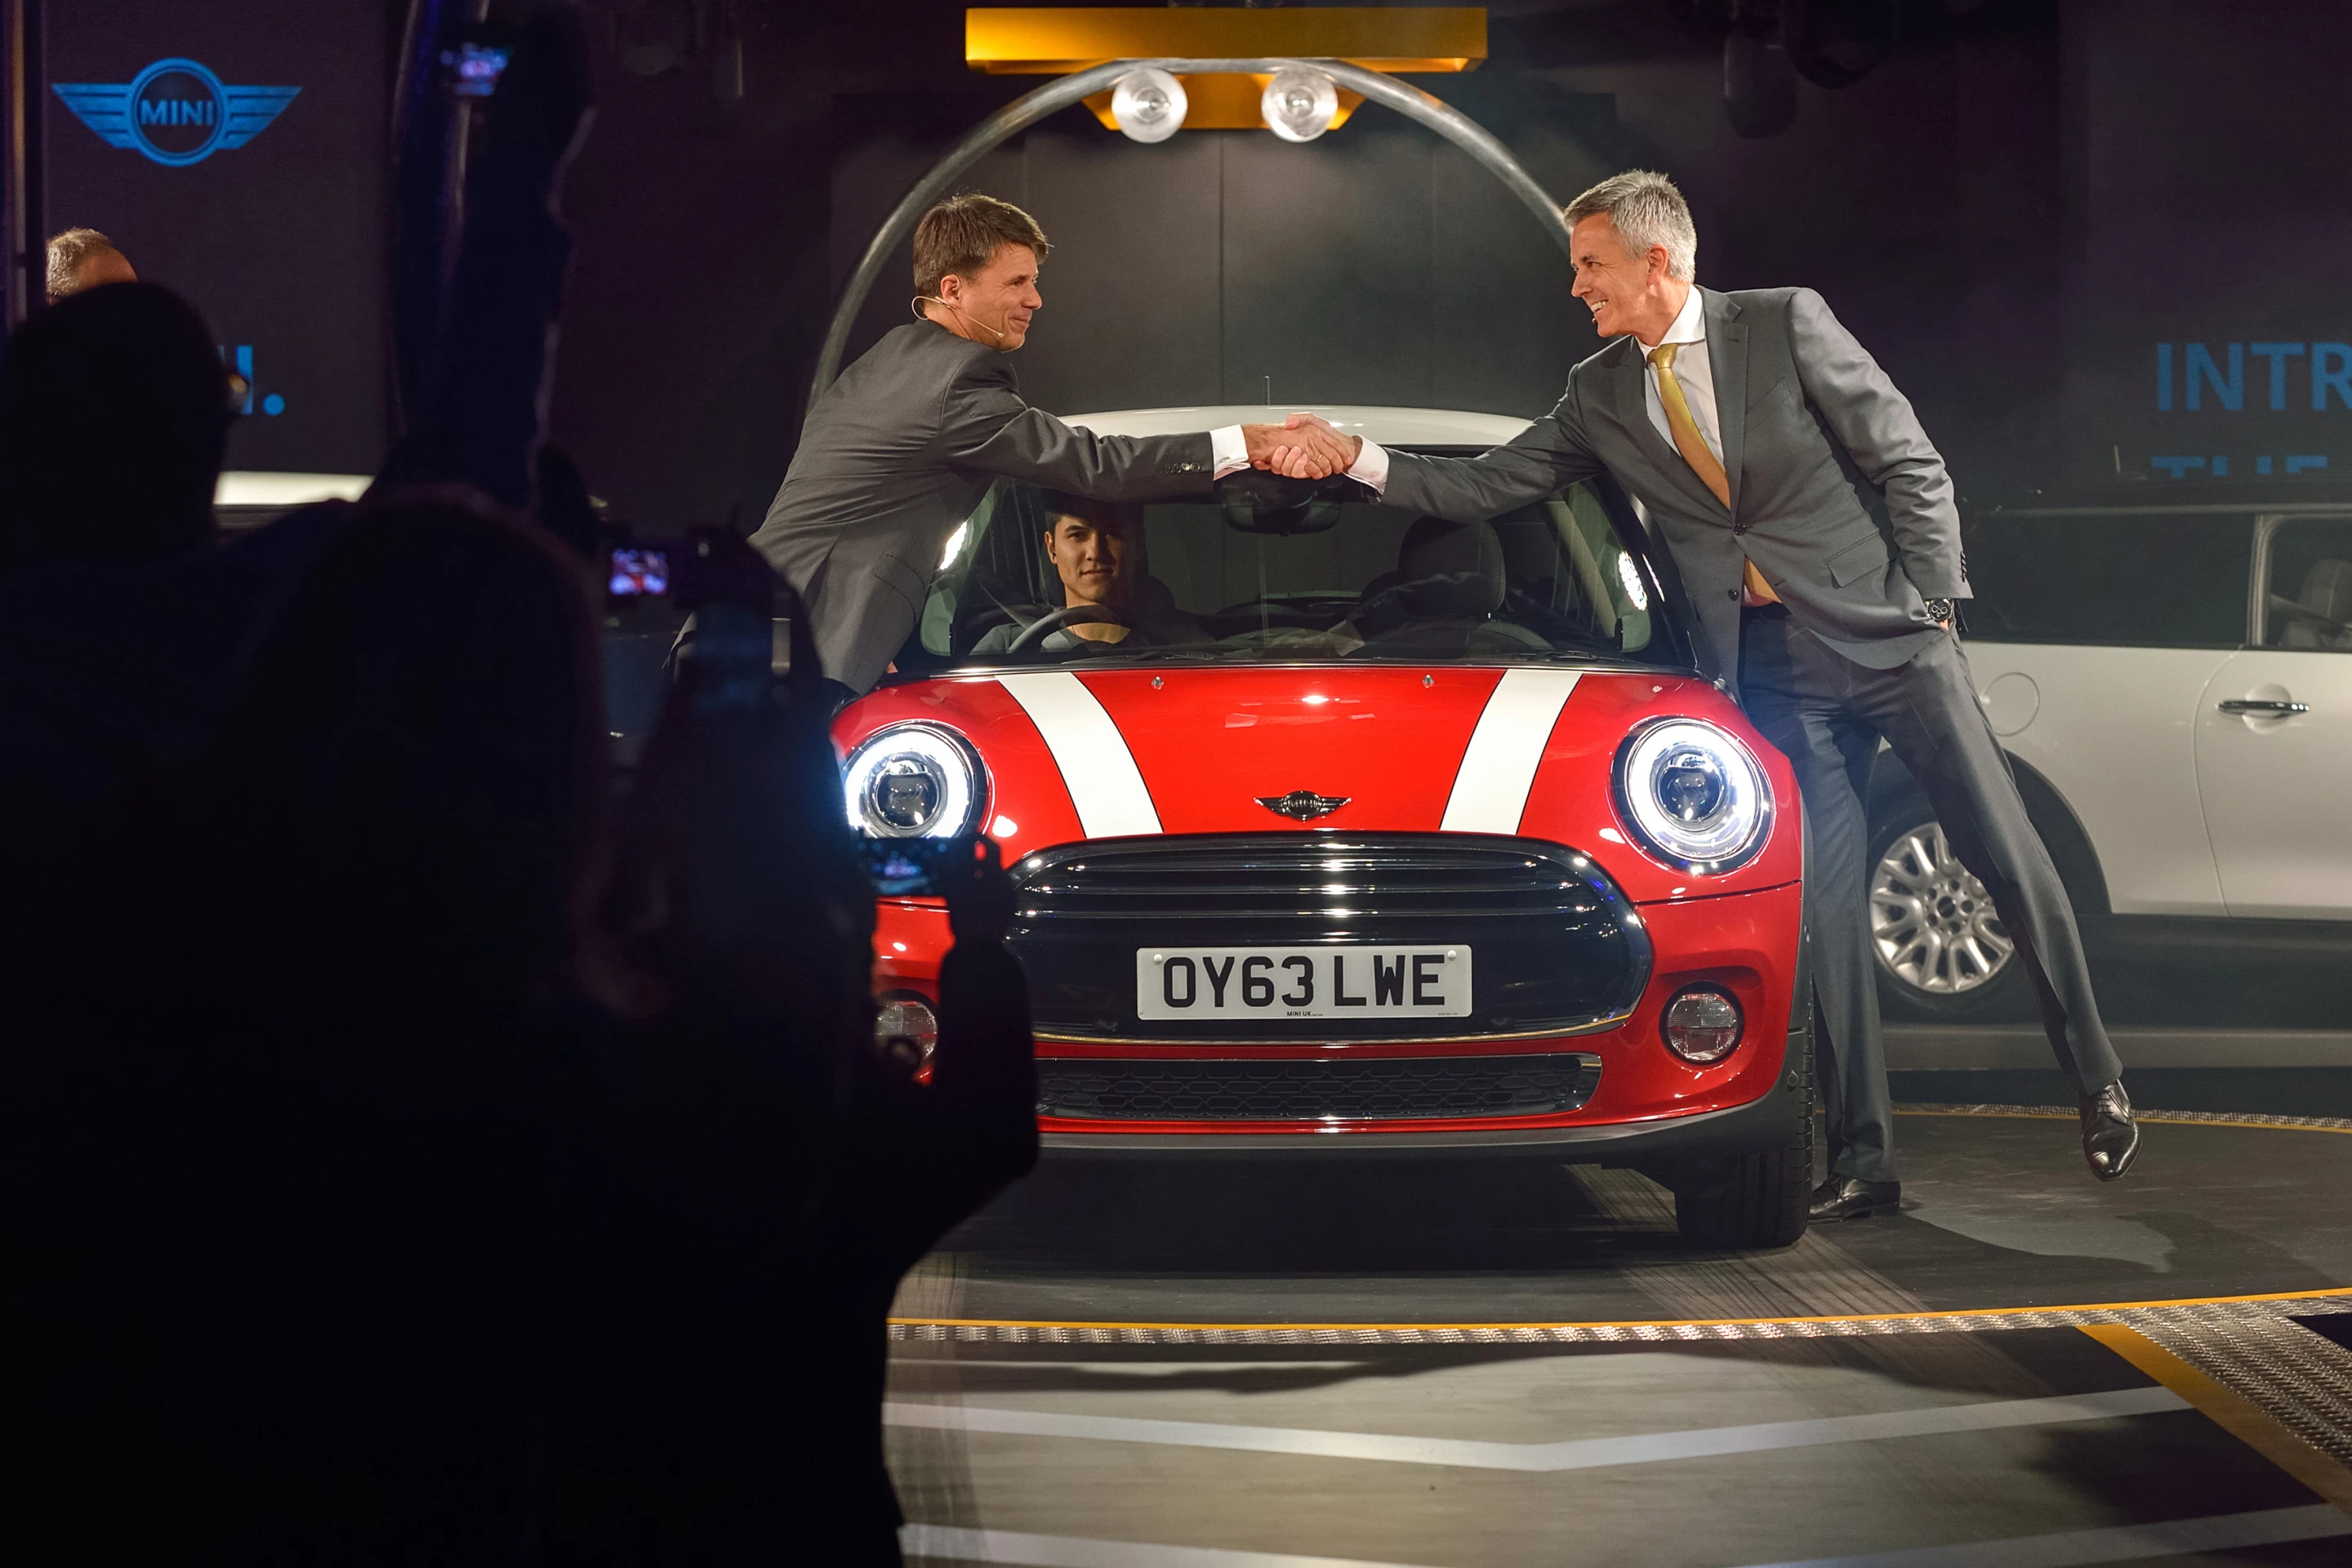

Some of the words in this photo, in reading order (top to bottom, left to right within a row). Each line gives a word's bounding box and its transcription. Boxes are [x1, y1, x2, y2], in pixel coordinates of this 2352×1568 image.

[140, 99, 213, 126] MINI
[2157, 341, 2352, 412] INTR
[1287, 800, 1317, 808] MINI
[1163, 956, 1314, 1008] OY63
[1334, 954, 1446, 1006] LWE
